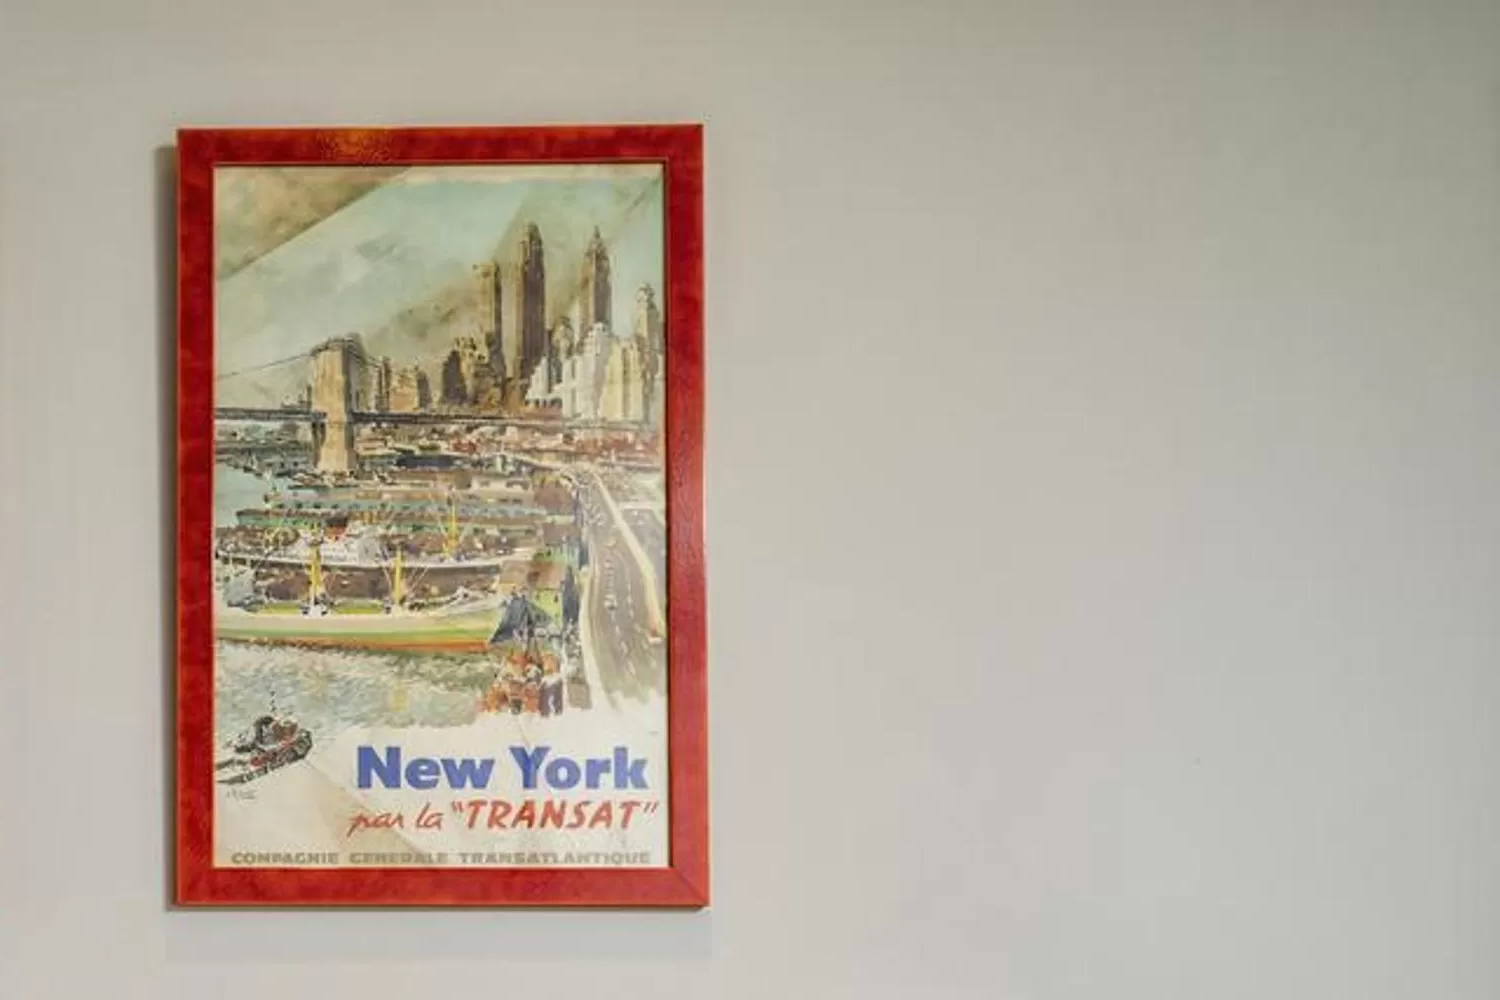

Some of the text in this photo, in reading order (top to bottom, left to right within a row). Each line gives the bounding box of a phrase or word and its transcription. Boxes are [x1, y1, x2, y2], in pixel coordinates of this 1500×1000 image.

[356, 746, 650, 790] New York
[346, 800, 659, 838] par la "TRANSAT"
[231, 852, 340, 865] COMPAGNIE
[460, 852, 651, 865] TRANSATLANTIQUE
